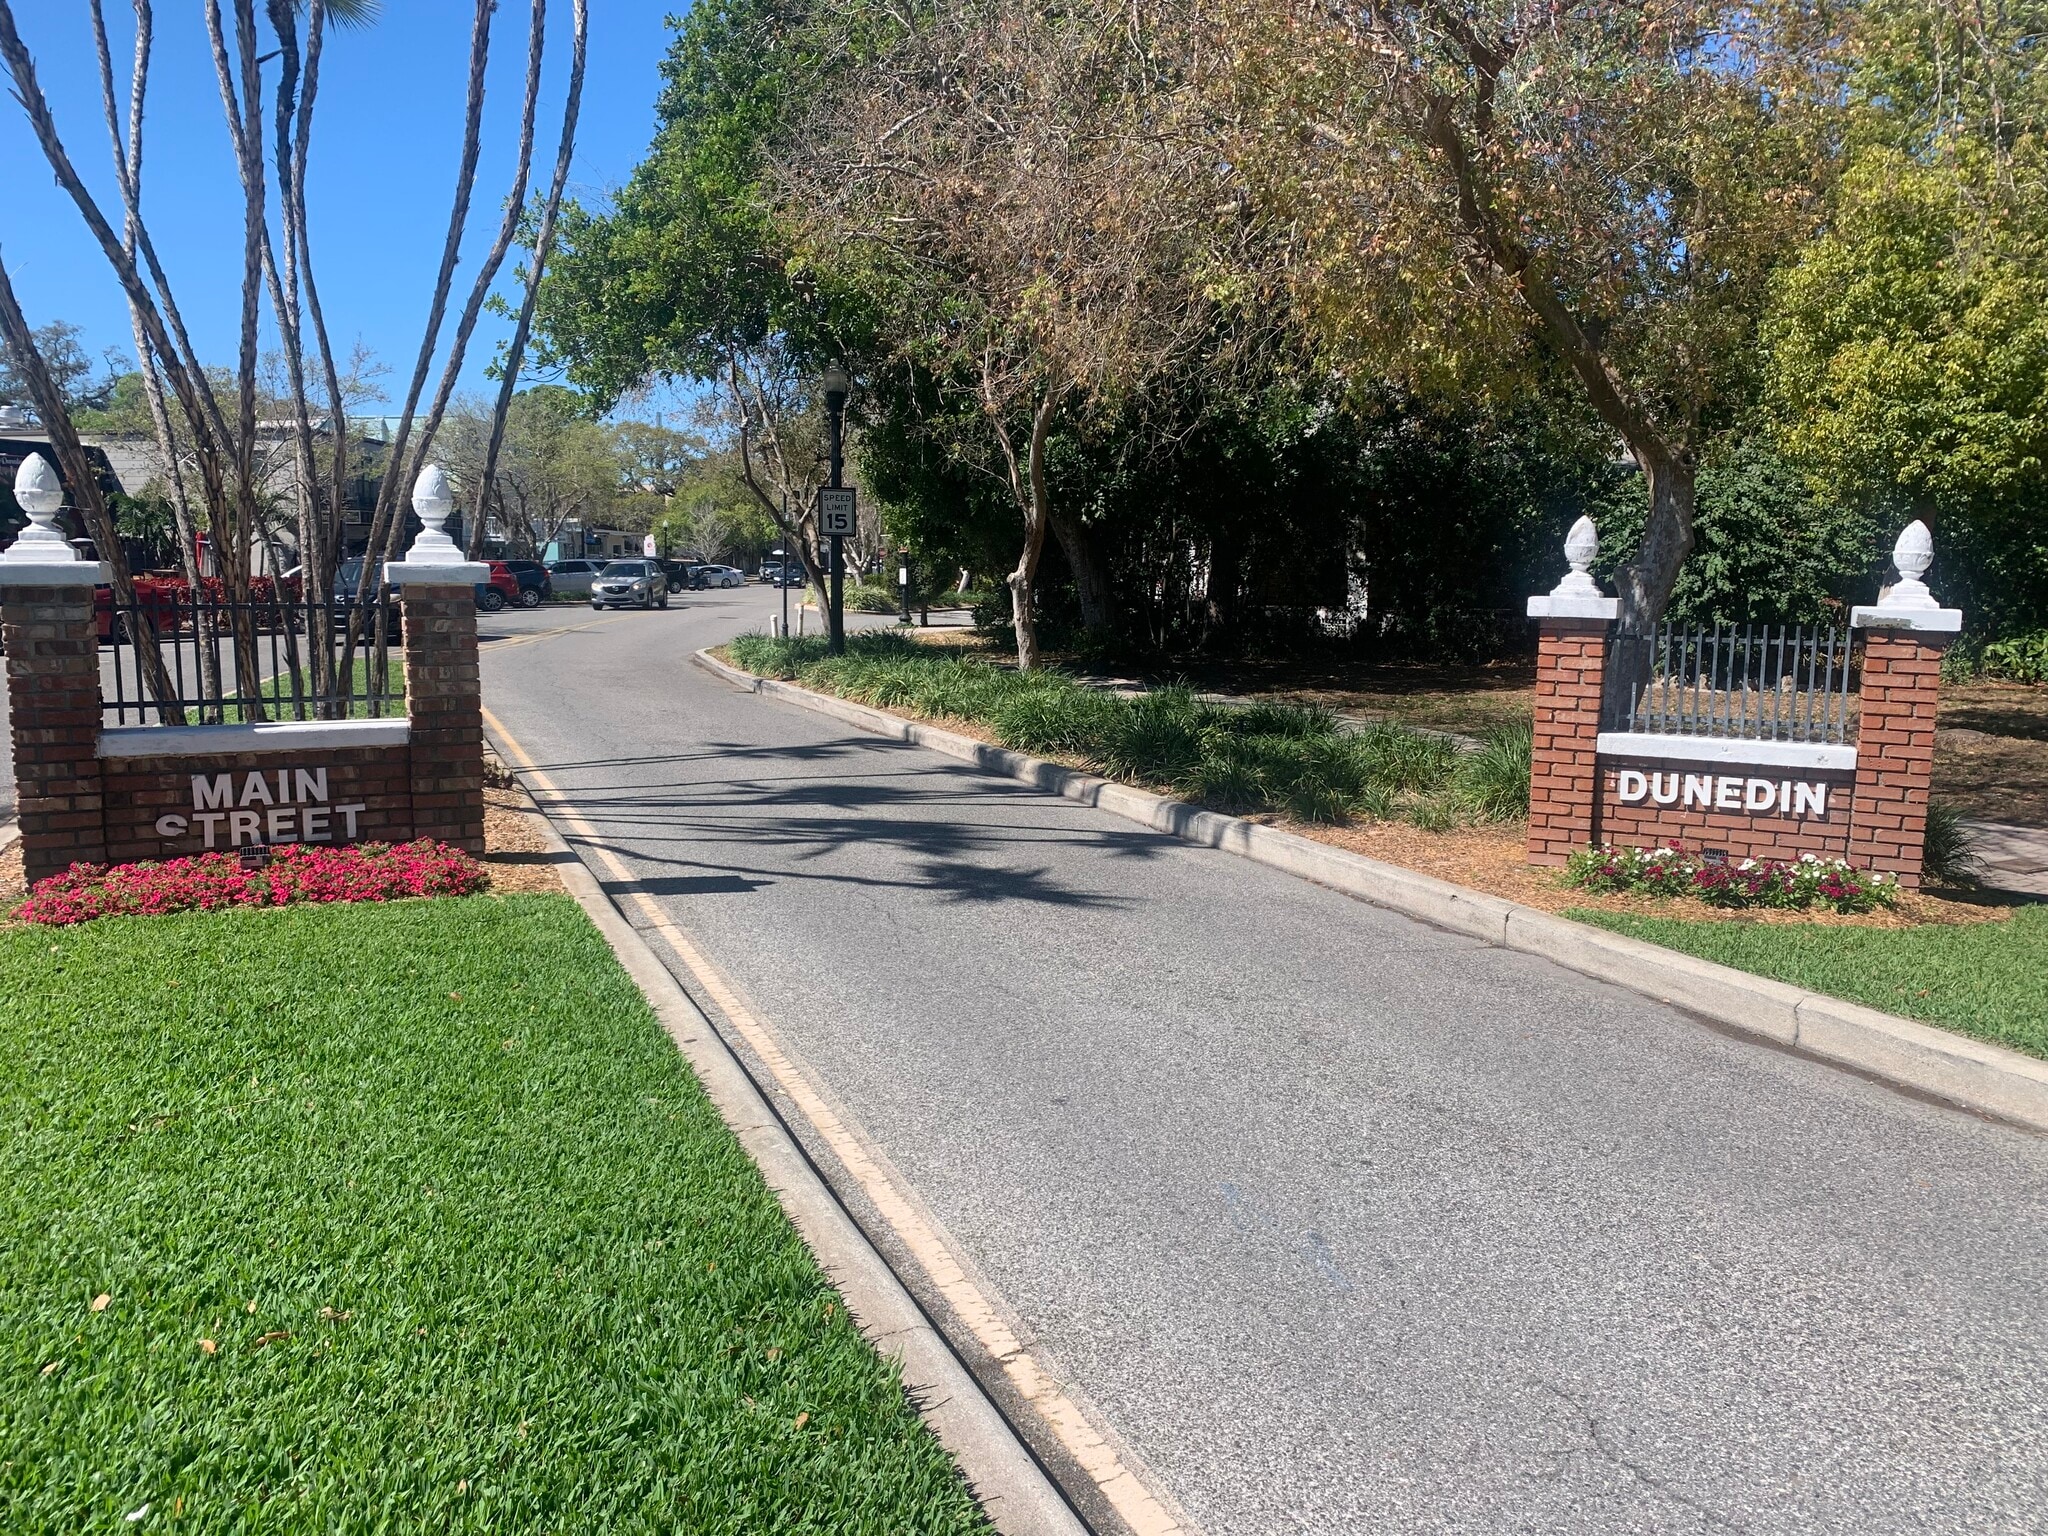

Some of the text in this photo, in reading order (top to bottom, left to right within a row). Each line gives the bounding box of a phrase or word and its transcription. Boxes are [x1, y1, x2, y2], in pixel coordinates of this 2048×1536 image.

[824, 494, 851, 502] SPEED
[827, 513, 848, 529] 15
[191, 767, 329, 811] MAIN
[1619, 770, 1826, 815] DUNEDIN
[155, 803, 366, 848] STREET
